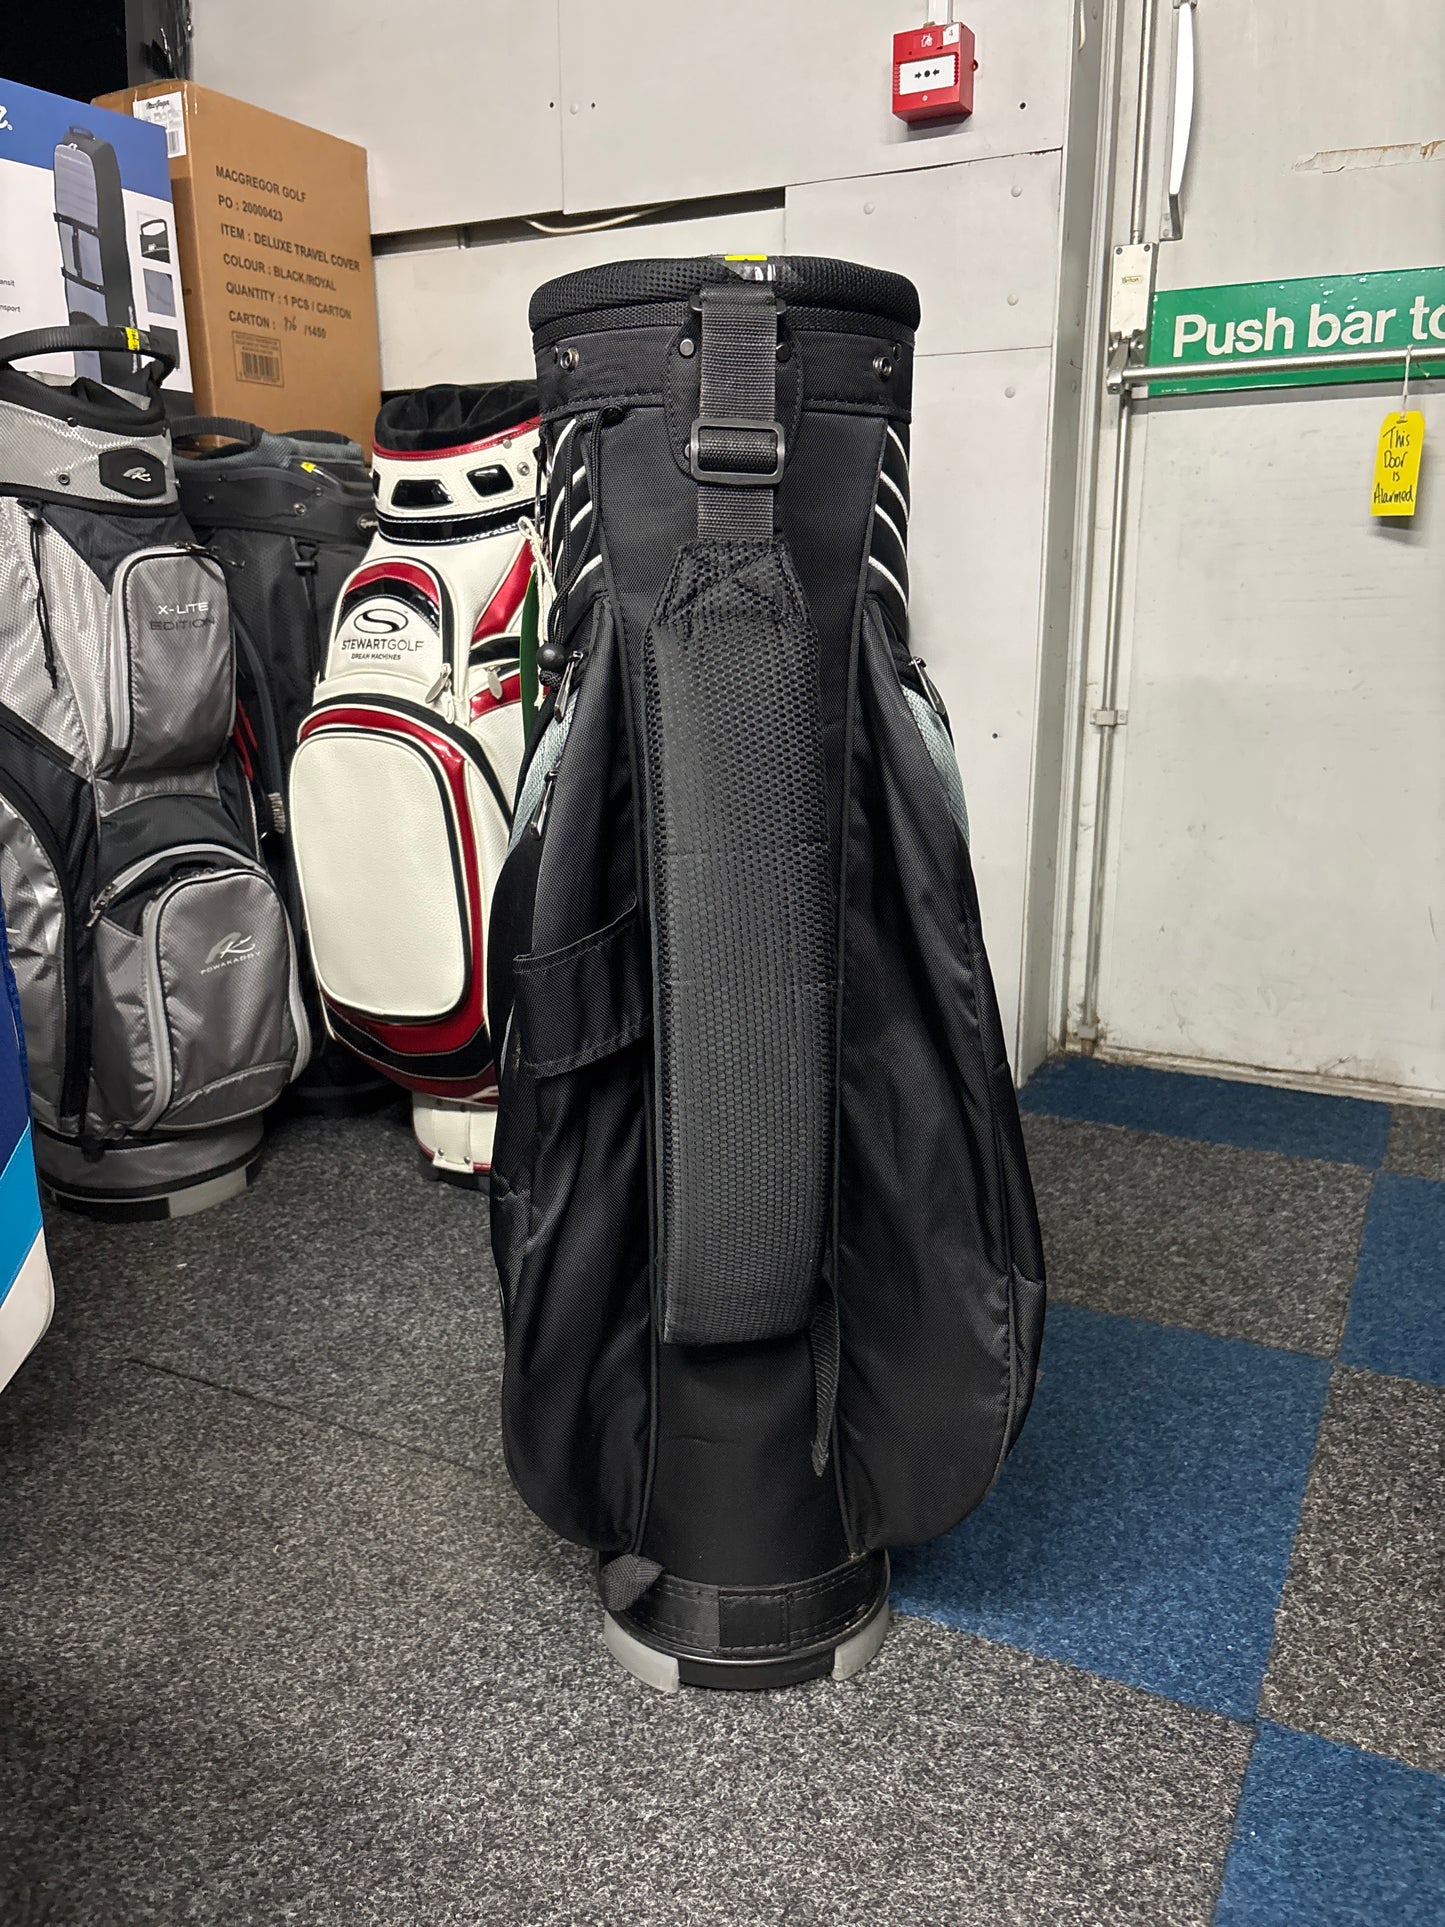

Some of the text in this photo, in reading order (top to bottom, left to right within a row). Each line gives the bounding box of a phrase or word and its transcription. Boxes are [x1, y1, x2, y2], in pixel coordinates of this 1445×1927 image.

[215, 165, 306, 203] MACGREGOR GOLF
[218, 194, 233, 209] PO
[242, 200, 283, 222] 20000423
[220, 223, 245, 241] ITEM
[254, 232, 293, 254] DELUXE
[294, 243, 329, 265] TRAVEL
[331, 254, 361, 272] COVER
[223, 253, 266, 273] COLOUR
[226, 281, 275, 302] QUANTITY
[291, 296, 310, 311] PCS
[316, 302, 352, 320] CARTON
[228, 310, 270, 329] CARTON
[1172, 306, 1295, 358] Push
[1307, 303, 1397, 348] bar
[1382, 426, 1410, 449] This
[1384, 449, 1408, 469] Door
[1392, 471, 1400, 482] is
[1373, 482, 1414, 504] Alarmed
[157, 601, 209, 615] X-LITE
[149, 616, 215, 631] EDITION
